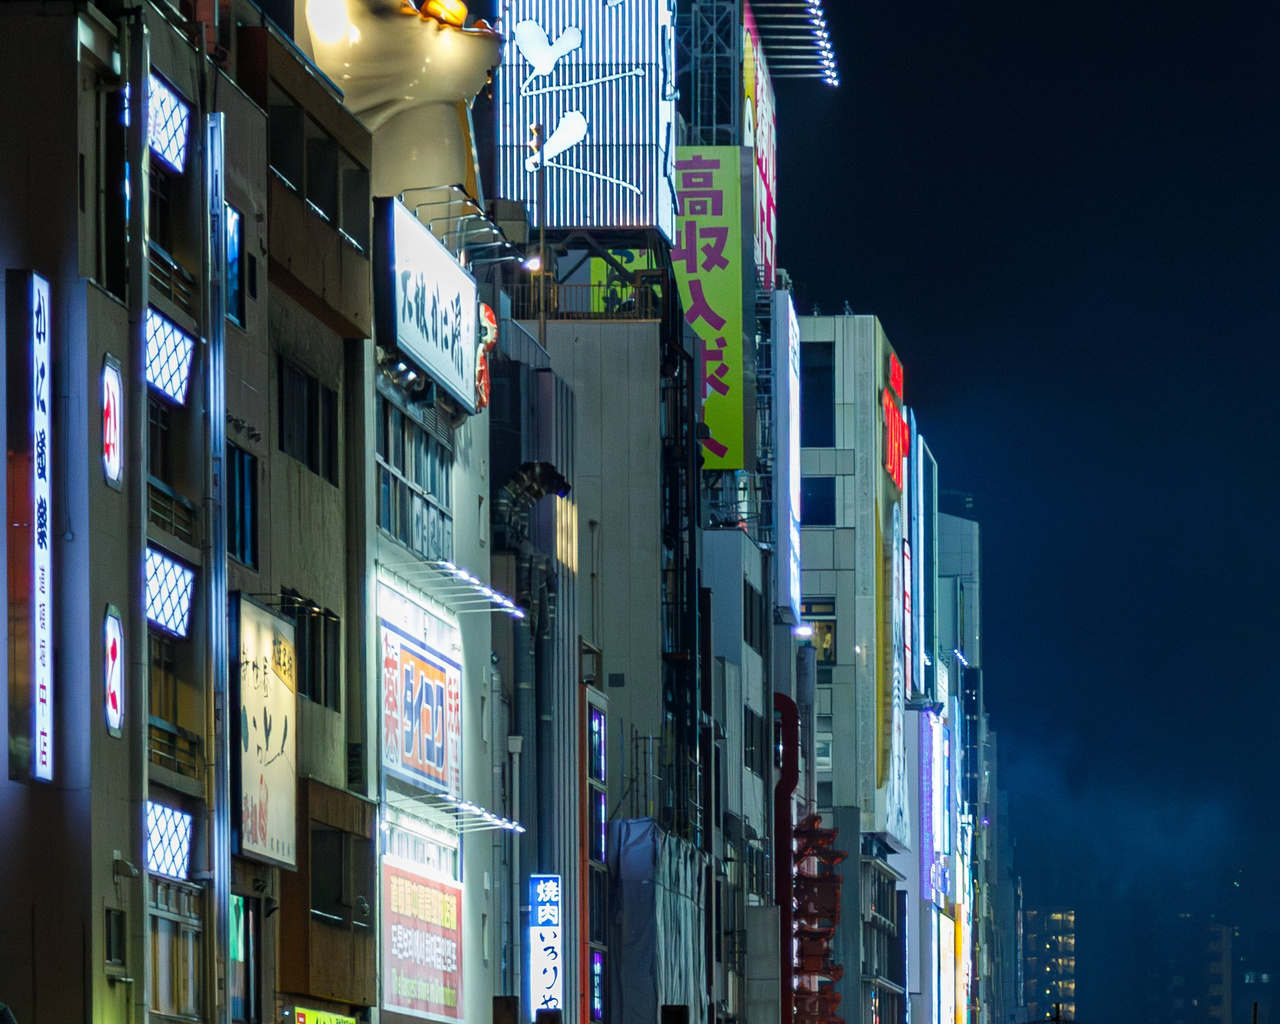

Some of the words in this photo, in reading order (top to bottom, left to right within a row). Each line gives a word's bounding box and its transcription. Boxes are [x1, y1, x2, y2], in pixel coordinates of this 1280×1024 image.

[536, 879, 560, 925] 焼肉
[539, 931, 560, 1009] いろりや
